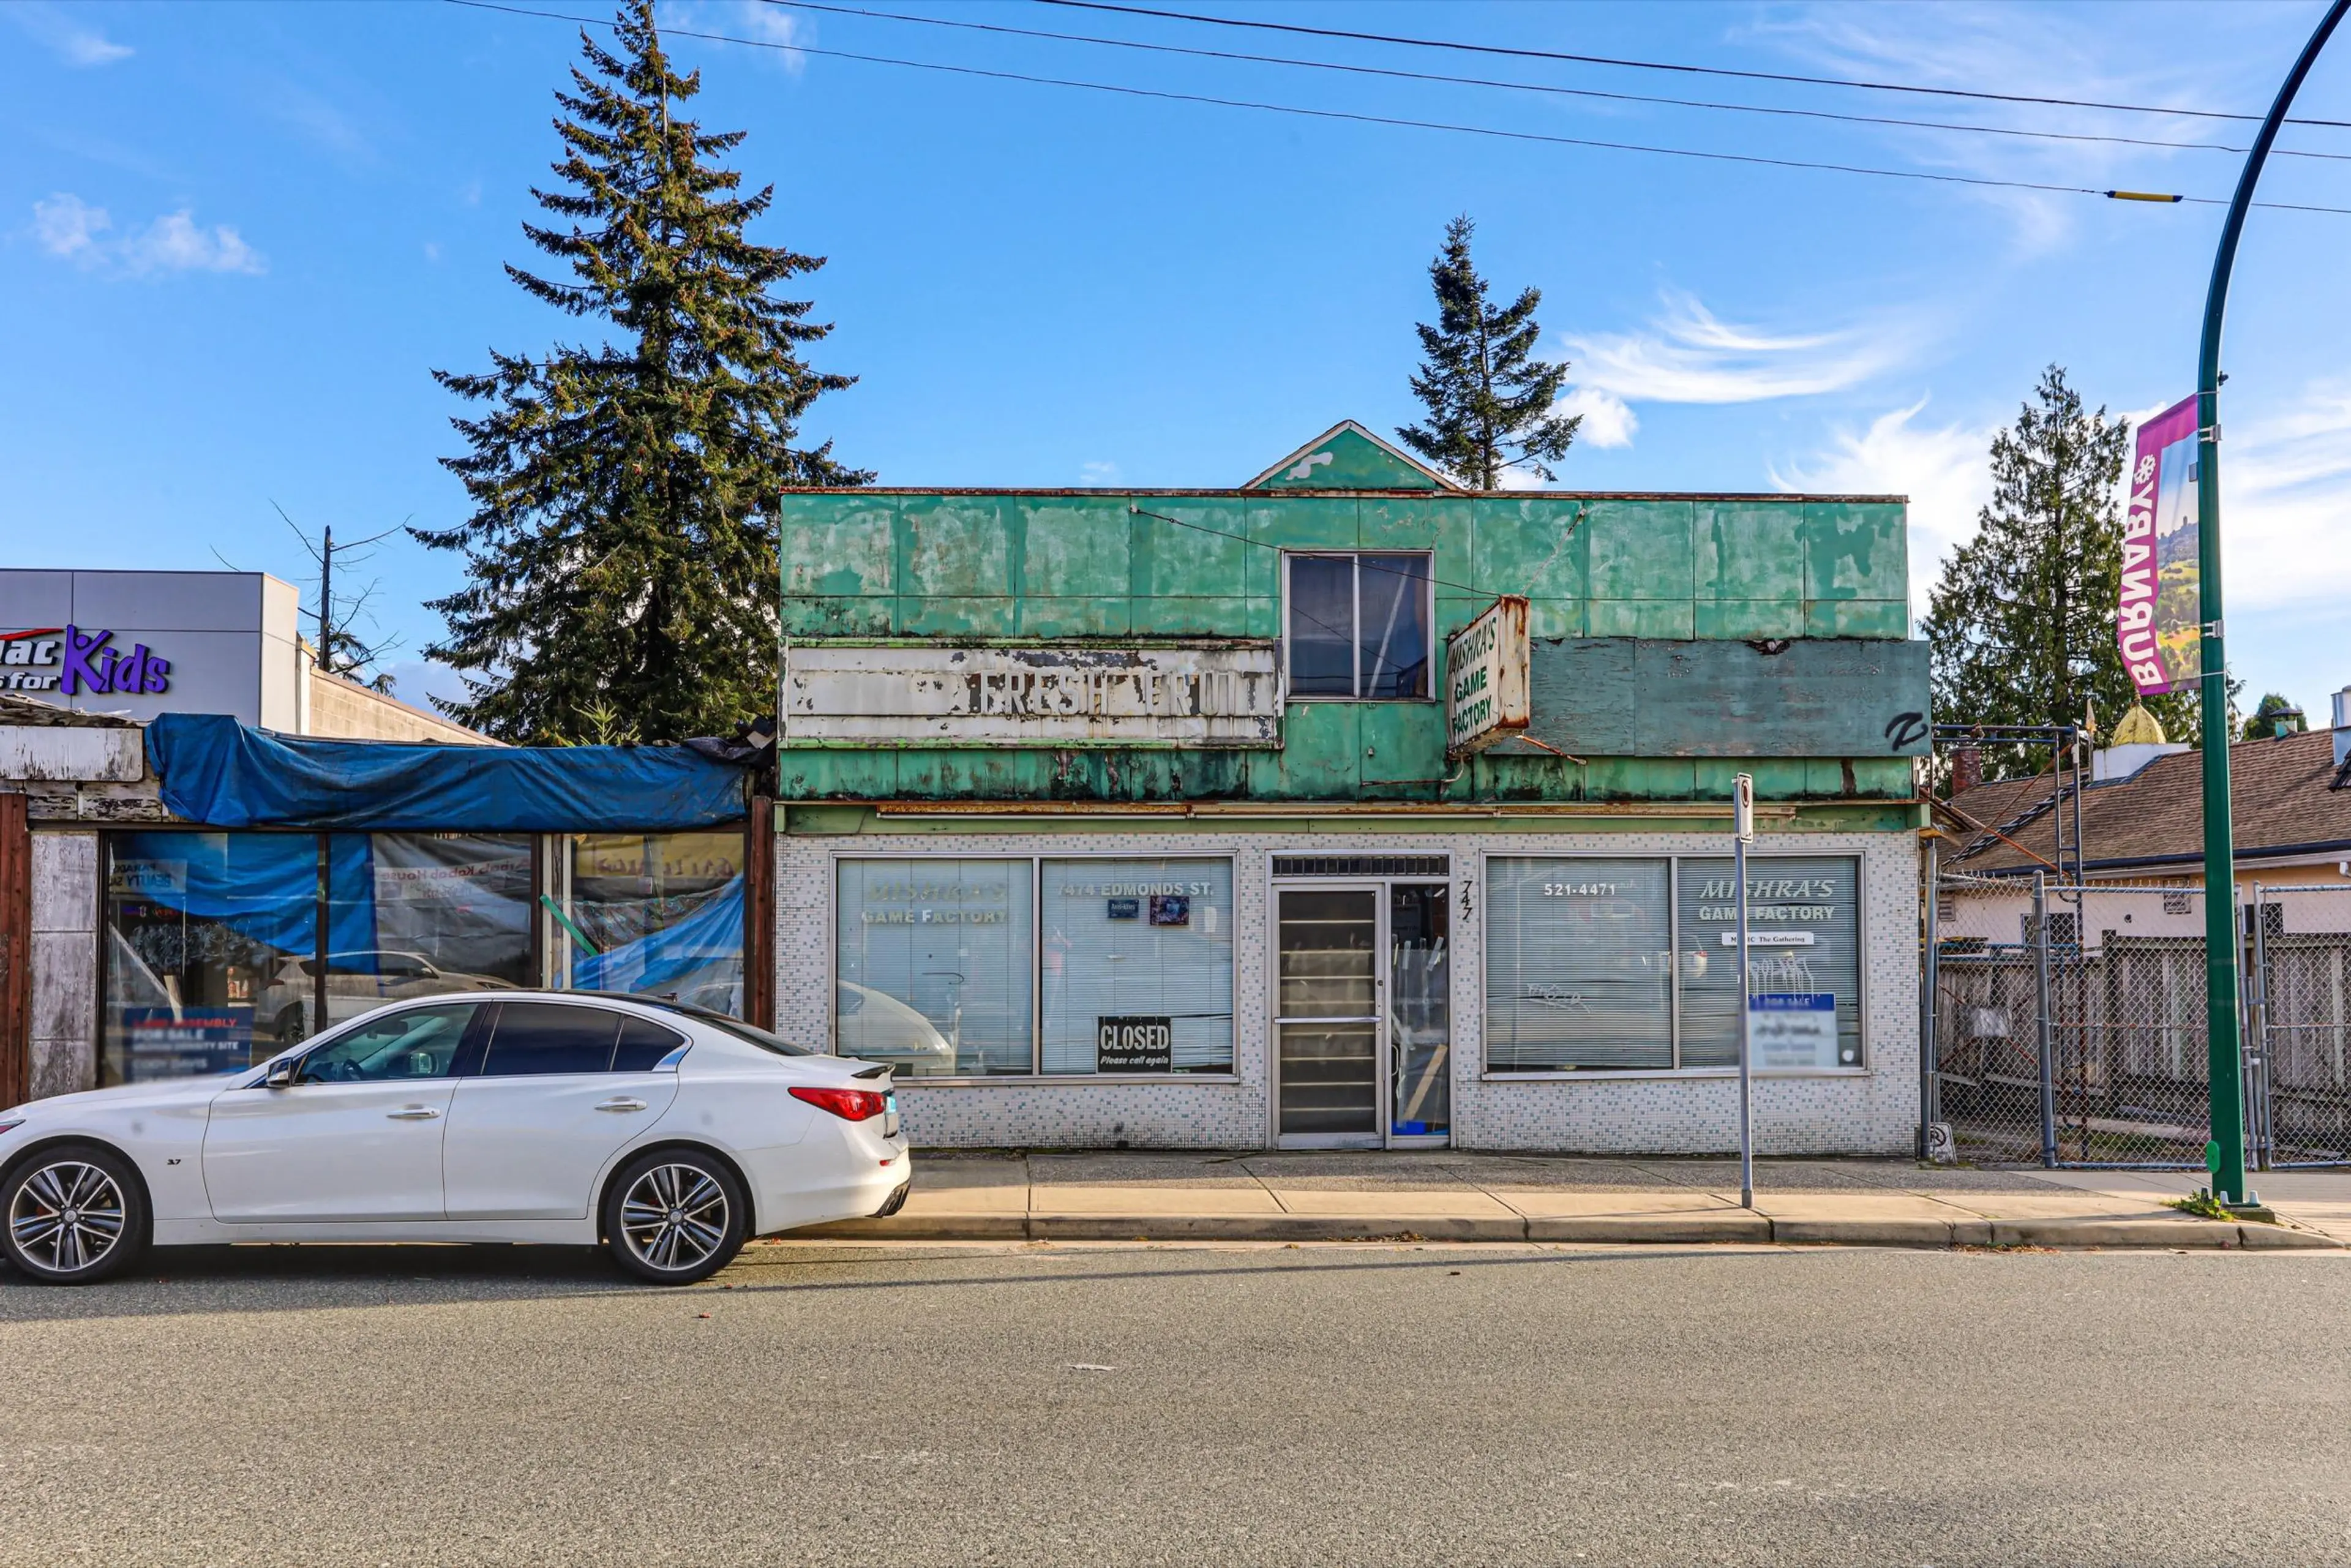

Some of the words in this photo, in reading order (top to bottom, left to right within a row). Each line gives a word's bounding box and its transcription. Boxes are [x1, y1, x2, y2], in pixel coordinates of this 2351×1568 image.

[0, 640, 59, 665] ac
[9, 672, 58, 690] for
[60, 624, 170, 695] Kids
[981, 670, 1108, 716] FRESH
[1455, 666, 1487, 703] GAME
[1452, 694, 1492, 735] FACTORY
[1101, 882, 1184, 896] EDMONDS
[1190, 882, 1213, 896] ST.
[922, 909, 1007, 923] FACTORY
[1699, 906, 1749, 920] GAM
[1755, 906, 1836, 920] FACTORY
[1773, 935, 1805, 944] Gathering
[1100, 1024, 1169, 1051] CLOSED
[1100, 1056, 1128, 1065] Please
[1129, 1056, 1146, 1065] call
[1146, 1056, 1169, 1067] again
